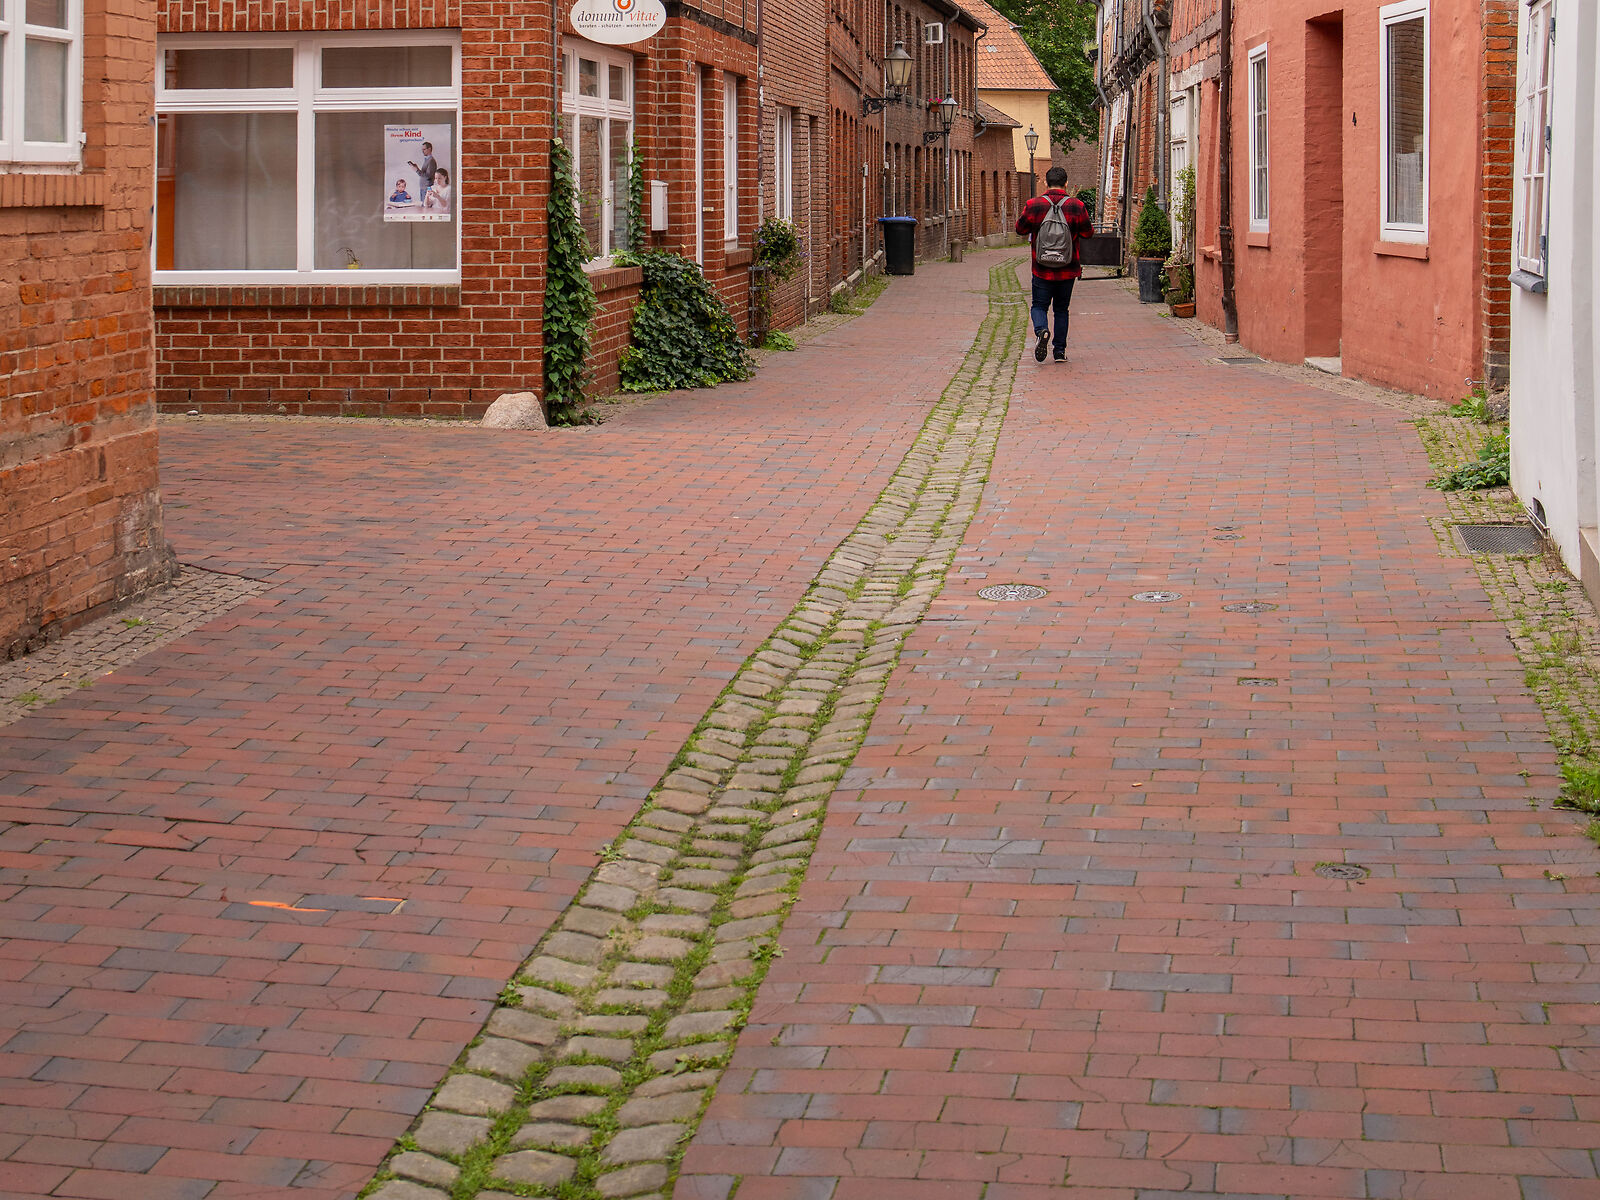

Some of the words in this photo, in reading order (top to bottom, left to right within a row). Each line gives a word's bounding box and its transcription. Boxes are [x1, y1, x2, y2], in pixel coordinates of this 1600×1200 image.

[577, 10, 619, 22] donum
[630, 10, 659, 21] vitae
[1352, 111, 1357, 126] 4
